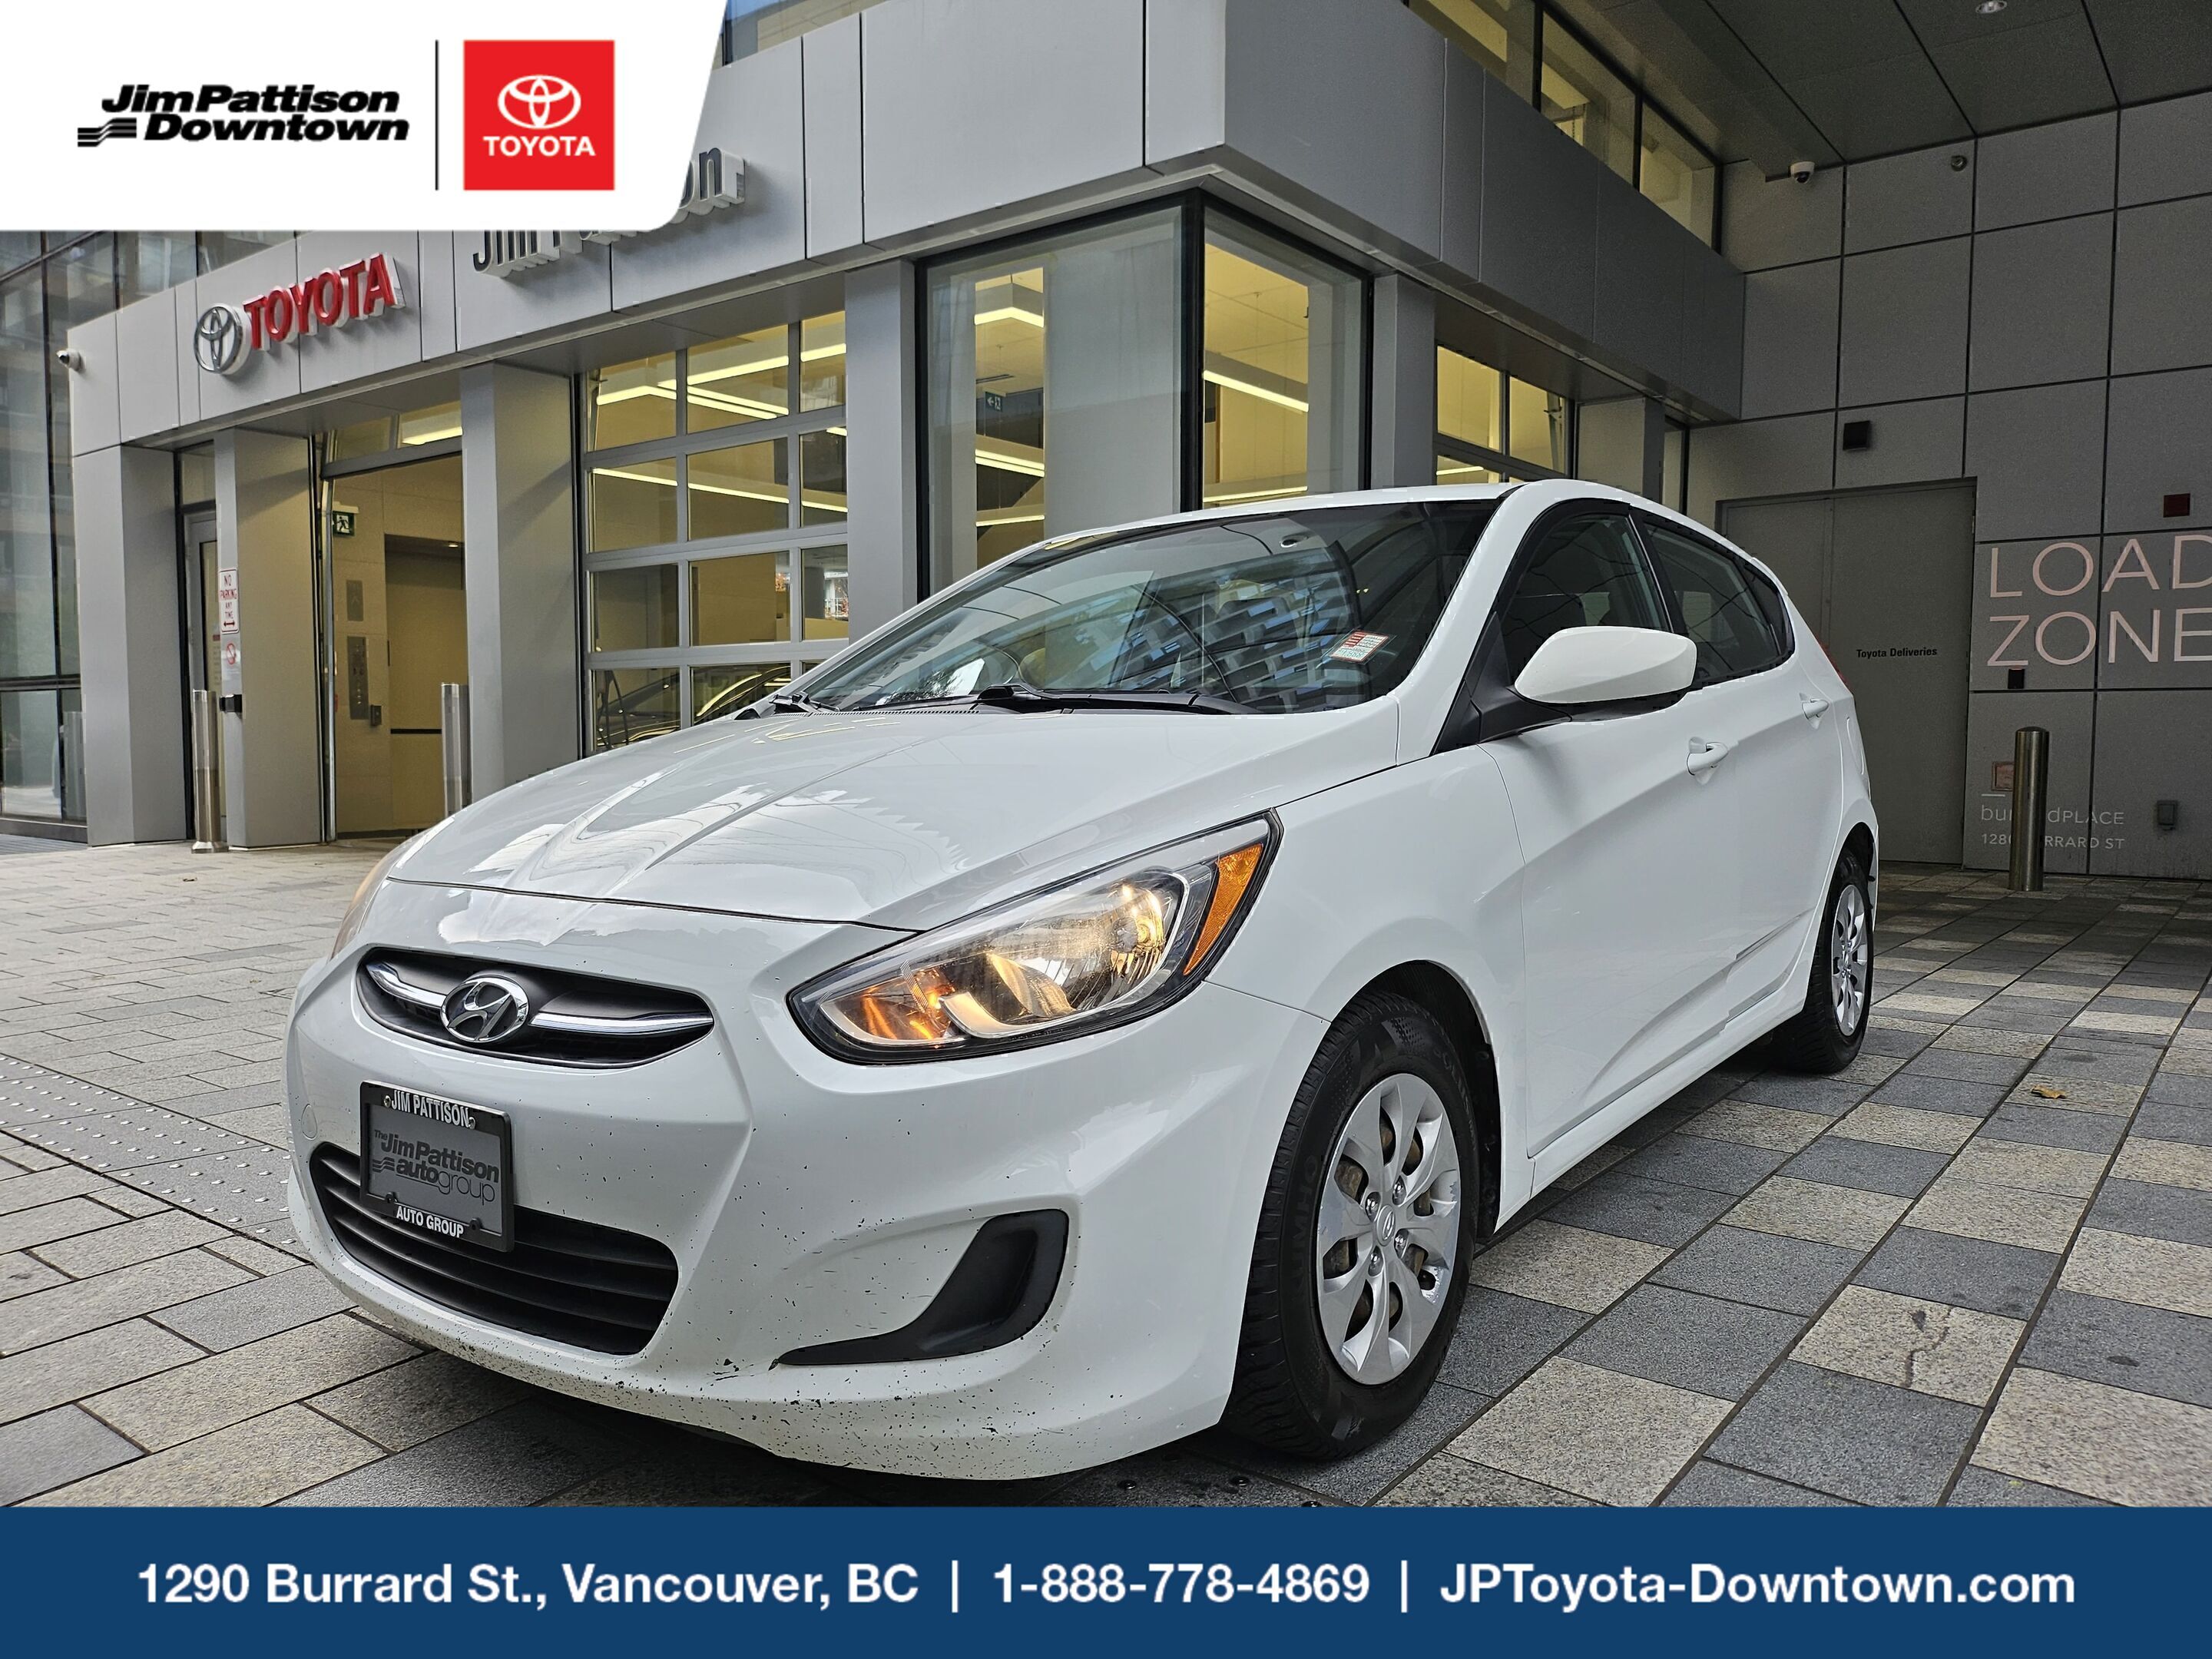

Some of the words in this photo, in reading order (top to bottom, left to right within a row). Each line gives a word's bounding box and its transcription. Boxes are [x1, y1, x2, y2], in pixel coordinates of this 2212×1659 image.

[243, 253, 398, 350] TOYOTA
[1990, 534, 2212, 597] LOAD
[1856, 649, 1887, 660] Toyota
[1889, 647, 1938, 657] Deliveries
[1987, 607, 2212, 667] ZONE
[1982, 833, 2012, 846] 128
[2045, 835, 2100, 849] RRARD
[2104, 838, 2125, 849] ST
[391, 1090, 410, 1113] JIM
[412, 1094, 470, 1128] PATTISON
[375, 1129, 388, 1141] The
[396, 1205, 423, 1227] AUTO
[426, 1214, 464, 1238] GROUP
